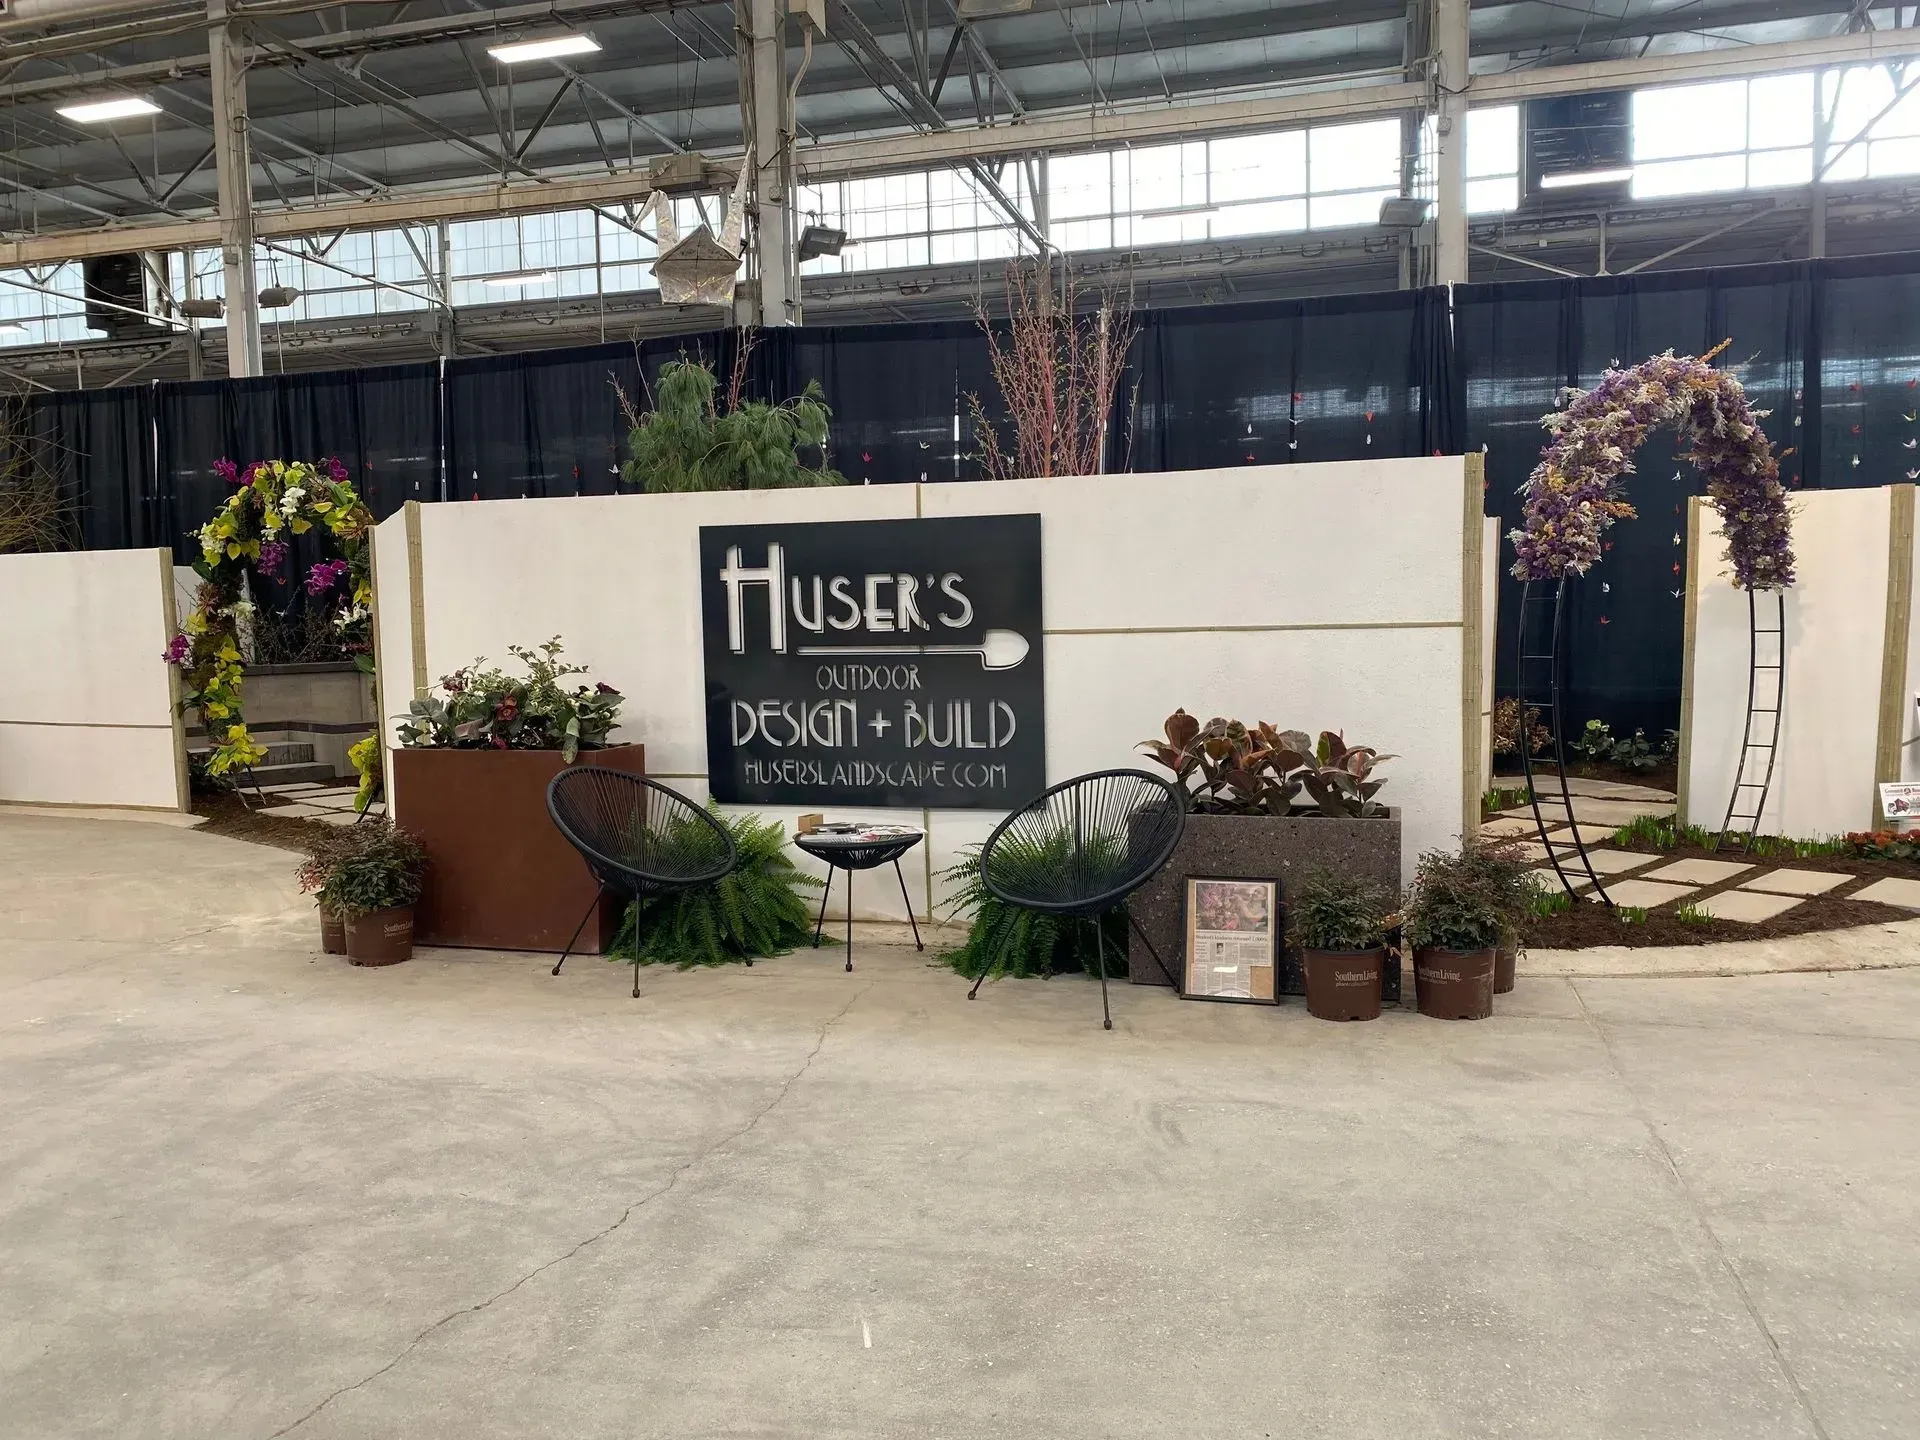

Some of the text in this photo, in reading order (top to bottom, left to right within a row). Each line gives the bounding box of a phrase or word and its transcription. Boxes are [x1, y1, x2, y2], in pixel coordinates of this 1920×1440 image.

[719, 541, 974, 655] HUSER'S
[816, 664, 922, 691] OUTDOOR
[730, 698, 1017, 749] DESIGN + BUILD
[1334, 970, 1363, 982] Southern
[1440, 969, 1462, 983] Living
